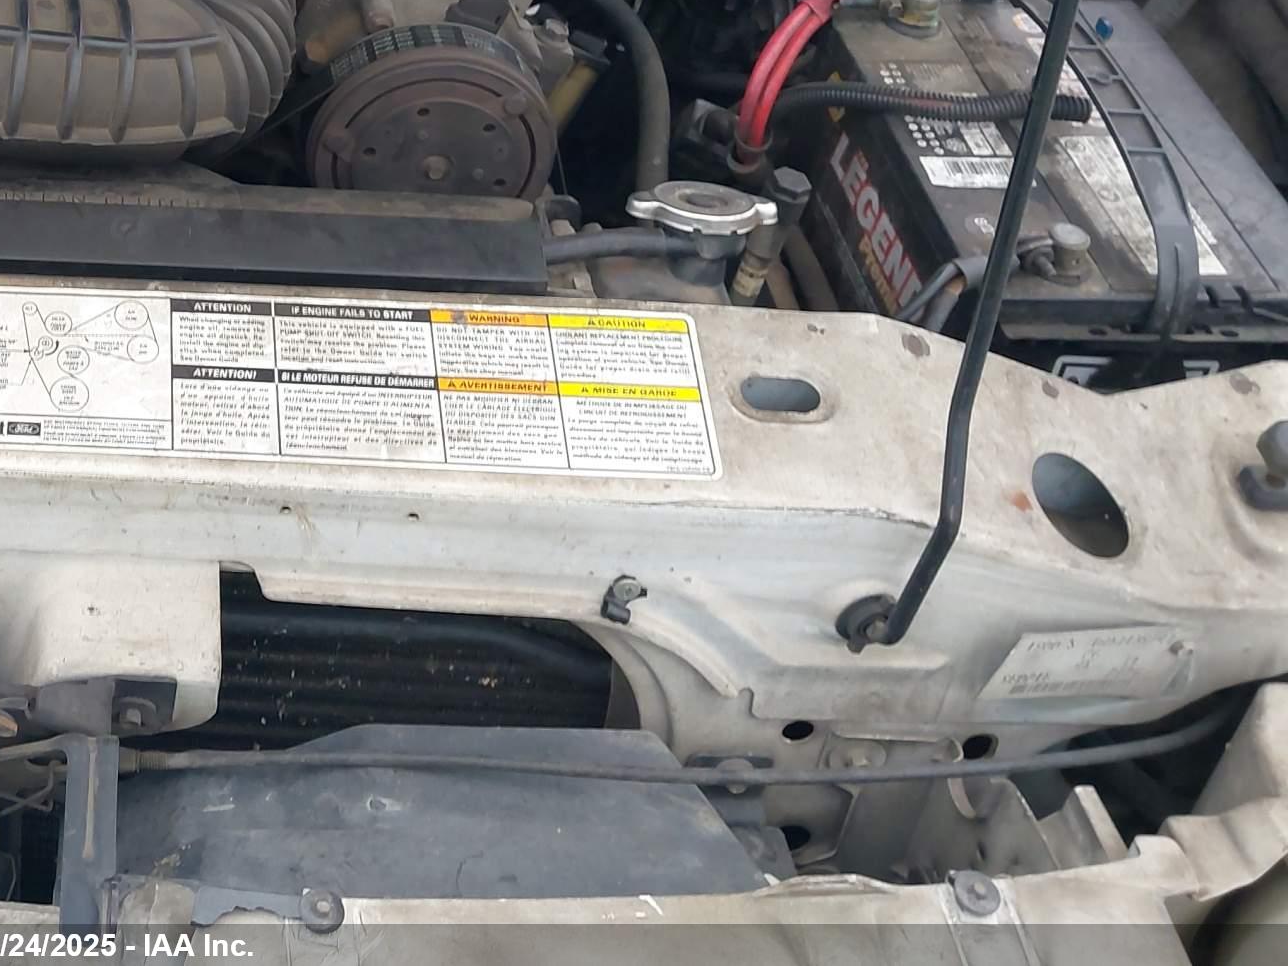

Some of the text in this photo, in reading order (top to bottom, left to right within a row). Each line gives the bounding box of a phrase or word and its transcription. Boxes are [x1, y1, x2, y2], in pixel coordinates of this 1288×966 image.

[194, 302, 252, 313] ATTENTION
[291, 306, 413, 320] IF ENGINE FAILS TO START
[469, 314, 520, 323] WARNING
[598, 320, 646, 328] CAUTION
[193, 368, 257, 380] ATTENTION!
[291, 372, 301, 381] LE
[303, 373, 339, 383] MOTEUR
[341, 375, 372, 385] REFUSE
[374, 376, 386, 386] DE
[459, 380, 547, 392] AVERTISSEMENT
[593, 386, 618, 394] MISE
[640, 388, 677, 397] GARDE
